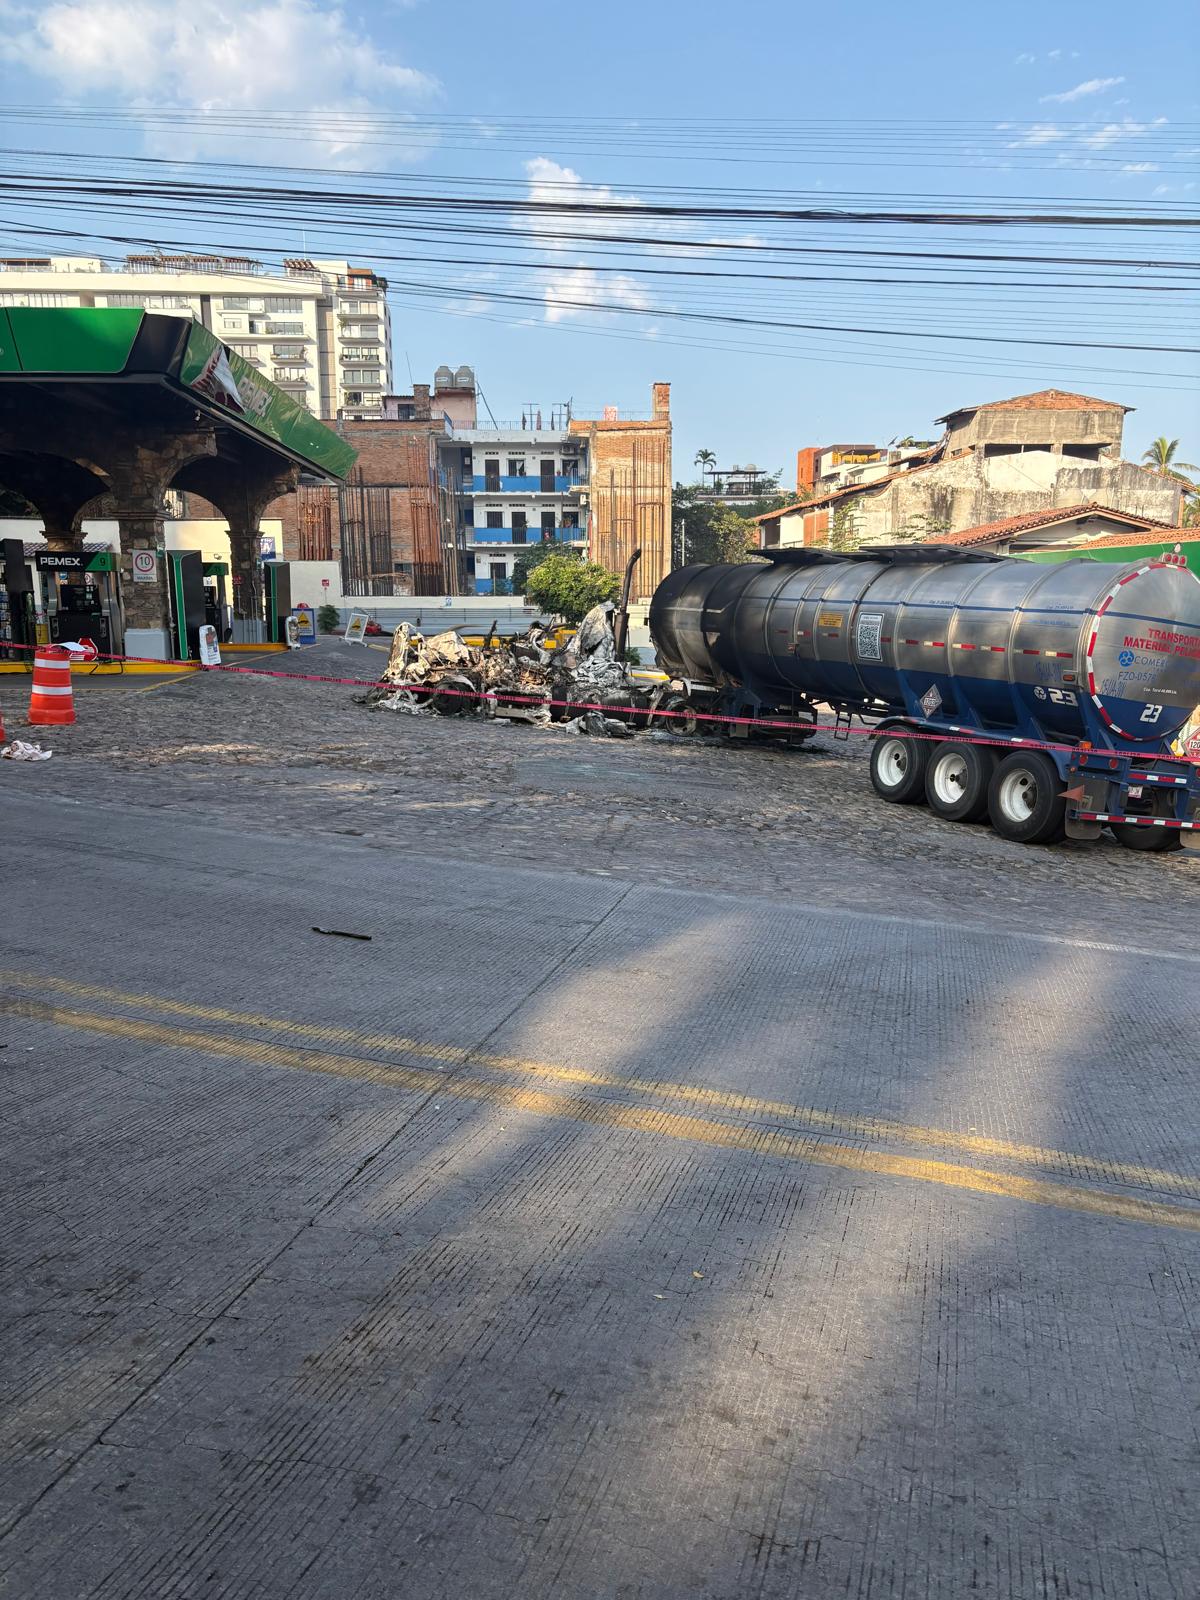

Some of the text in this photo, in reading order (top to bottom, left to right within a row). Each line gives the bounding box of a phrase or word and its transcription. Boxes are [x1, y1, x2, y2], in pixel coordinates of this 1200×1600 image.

[40, 557, 80, 566] PEMEX
[99, 557, 106, 567] 9
[139, 556, 151, 566] 10
[1048, 688, 1079, 707] 23
[1140, 704, 1163, 723] 23
